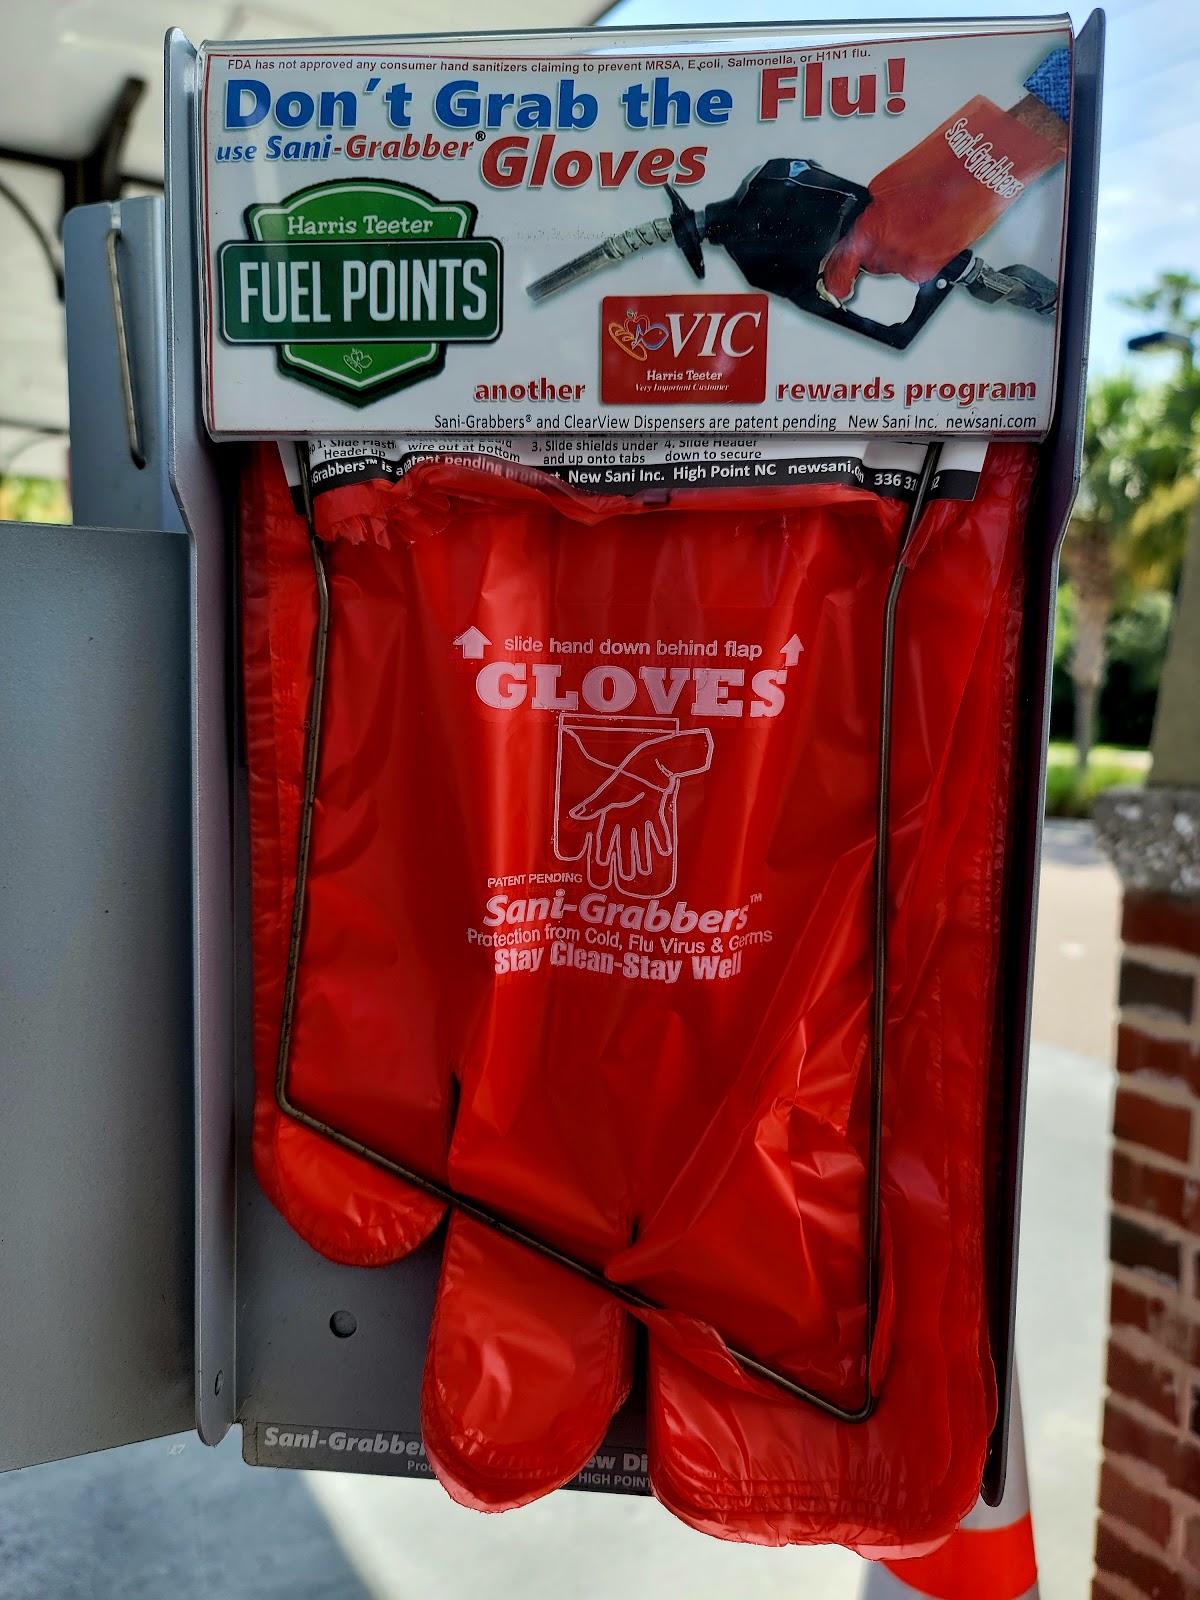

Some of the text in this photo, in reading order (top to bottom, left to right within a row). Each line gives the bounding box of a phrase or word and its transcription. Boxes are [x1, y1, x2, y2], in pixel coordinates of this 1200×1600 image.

[228, 60, 251, 70] FDA
[255, 60, 274, 70] has
[278, 60, 296, 70] not
[300, 60, 352, 71] approved
[356, 61, 376, 72] any
[380, 62, 436, 71] consumer
[440, 62, 468, 72] hand
[472, 62, 527, 72] sanitizers
[531, 62, 579, 74] claiming
[583, 63, 594, 72] to
[598, 62, 641, 73] prevent
[645, 60, 684, 72] MRSA,
[727, 55, 796, 68] Salmonella,
[800, 54, 812, 63] or
[816, 50, 848, 62] H1N1
[851, 49, 871, 58] flu.
[434, 79, 598, 130] Grab
[621, 76, 733, 128] the
[759, 58, 906, 121] Flu!
[216, 143, 257, 162] use
[481, 134, 708, 189] Gloves
[945, 118, 1024, 198] Sani-Grabbers
[287, 215, 433, 235] Harris Teeter
[239, 258, 487, 323] FUEL POINTS
[665, 311, 762, 358] VIC
[647, 370, 723, 381] Harris Teeter
[474, 377, 585, 401] another
[635, 383, 729, 393] Very Important Customer
[776, 377, 1037, 408] rewards program
[536, 415, 560, 429] and
[564, 414, 630, 429] ClearView
[633, 414, 705, 432] Dispensers
[708, 418, 730, 430] are
[734, 416, 778, 432] patent
[782, 414, 837, 431] pending
[848, 414, 1037, 429] New Sani Inc. newsani.com
[317, 440, 326, 449] 1.
[330, 439, 356, 447] Slide
[324, 448, 367, 459] Header
[371, 447, 386, 458] up
[408, 442, 520, 463] wire out at bottom
[531, 441, 542, 452] 3.
[545, 440, 573, 452] Slide
[576, 440, 618, 452] shields
[622, 440, 658, 451] under
[664, 440, 675, 449] 4.
[679, 440, 709, 448] Slide
[543, 452, 645, 466] and up onto tabs
[665, 450, 762, 461] down to secure
[381, 461, 392, 473] is
[396, 467, 404, 476] a
[444, 455, 503, 475] pending
[568, 470, 601, 483] New
[605, 468, 635, 483] Sani
[640, 469, 665, 482] Inc.
[673, 465, 706, 482] High
[711, 464, 750, 478] Point
[754, 464, 776, 476] NC
[874, 473, 901, 487] 336
[504, 636, 763, 661] slide hand down behind flap
[476, 661, 787, 718] GLOVES
[487, 872, 583, 888] PATENT PENDING
[467, 923, 773, 954] Protection from Cold, Flu Virus & Germs
[494, 941, 742, 984] Stay Clean-Stay Well
[578, 1472, 651, 1488] HIGH POINT
